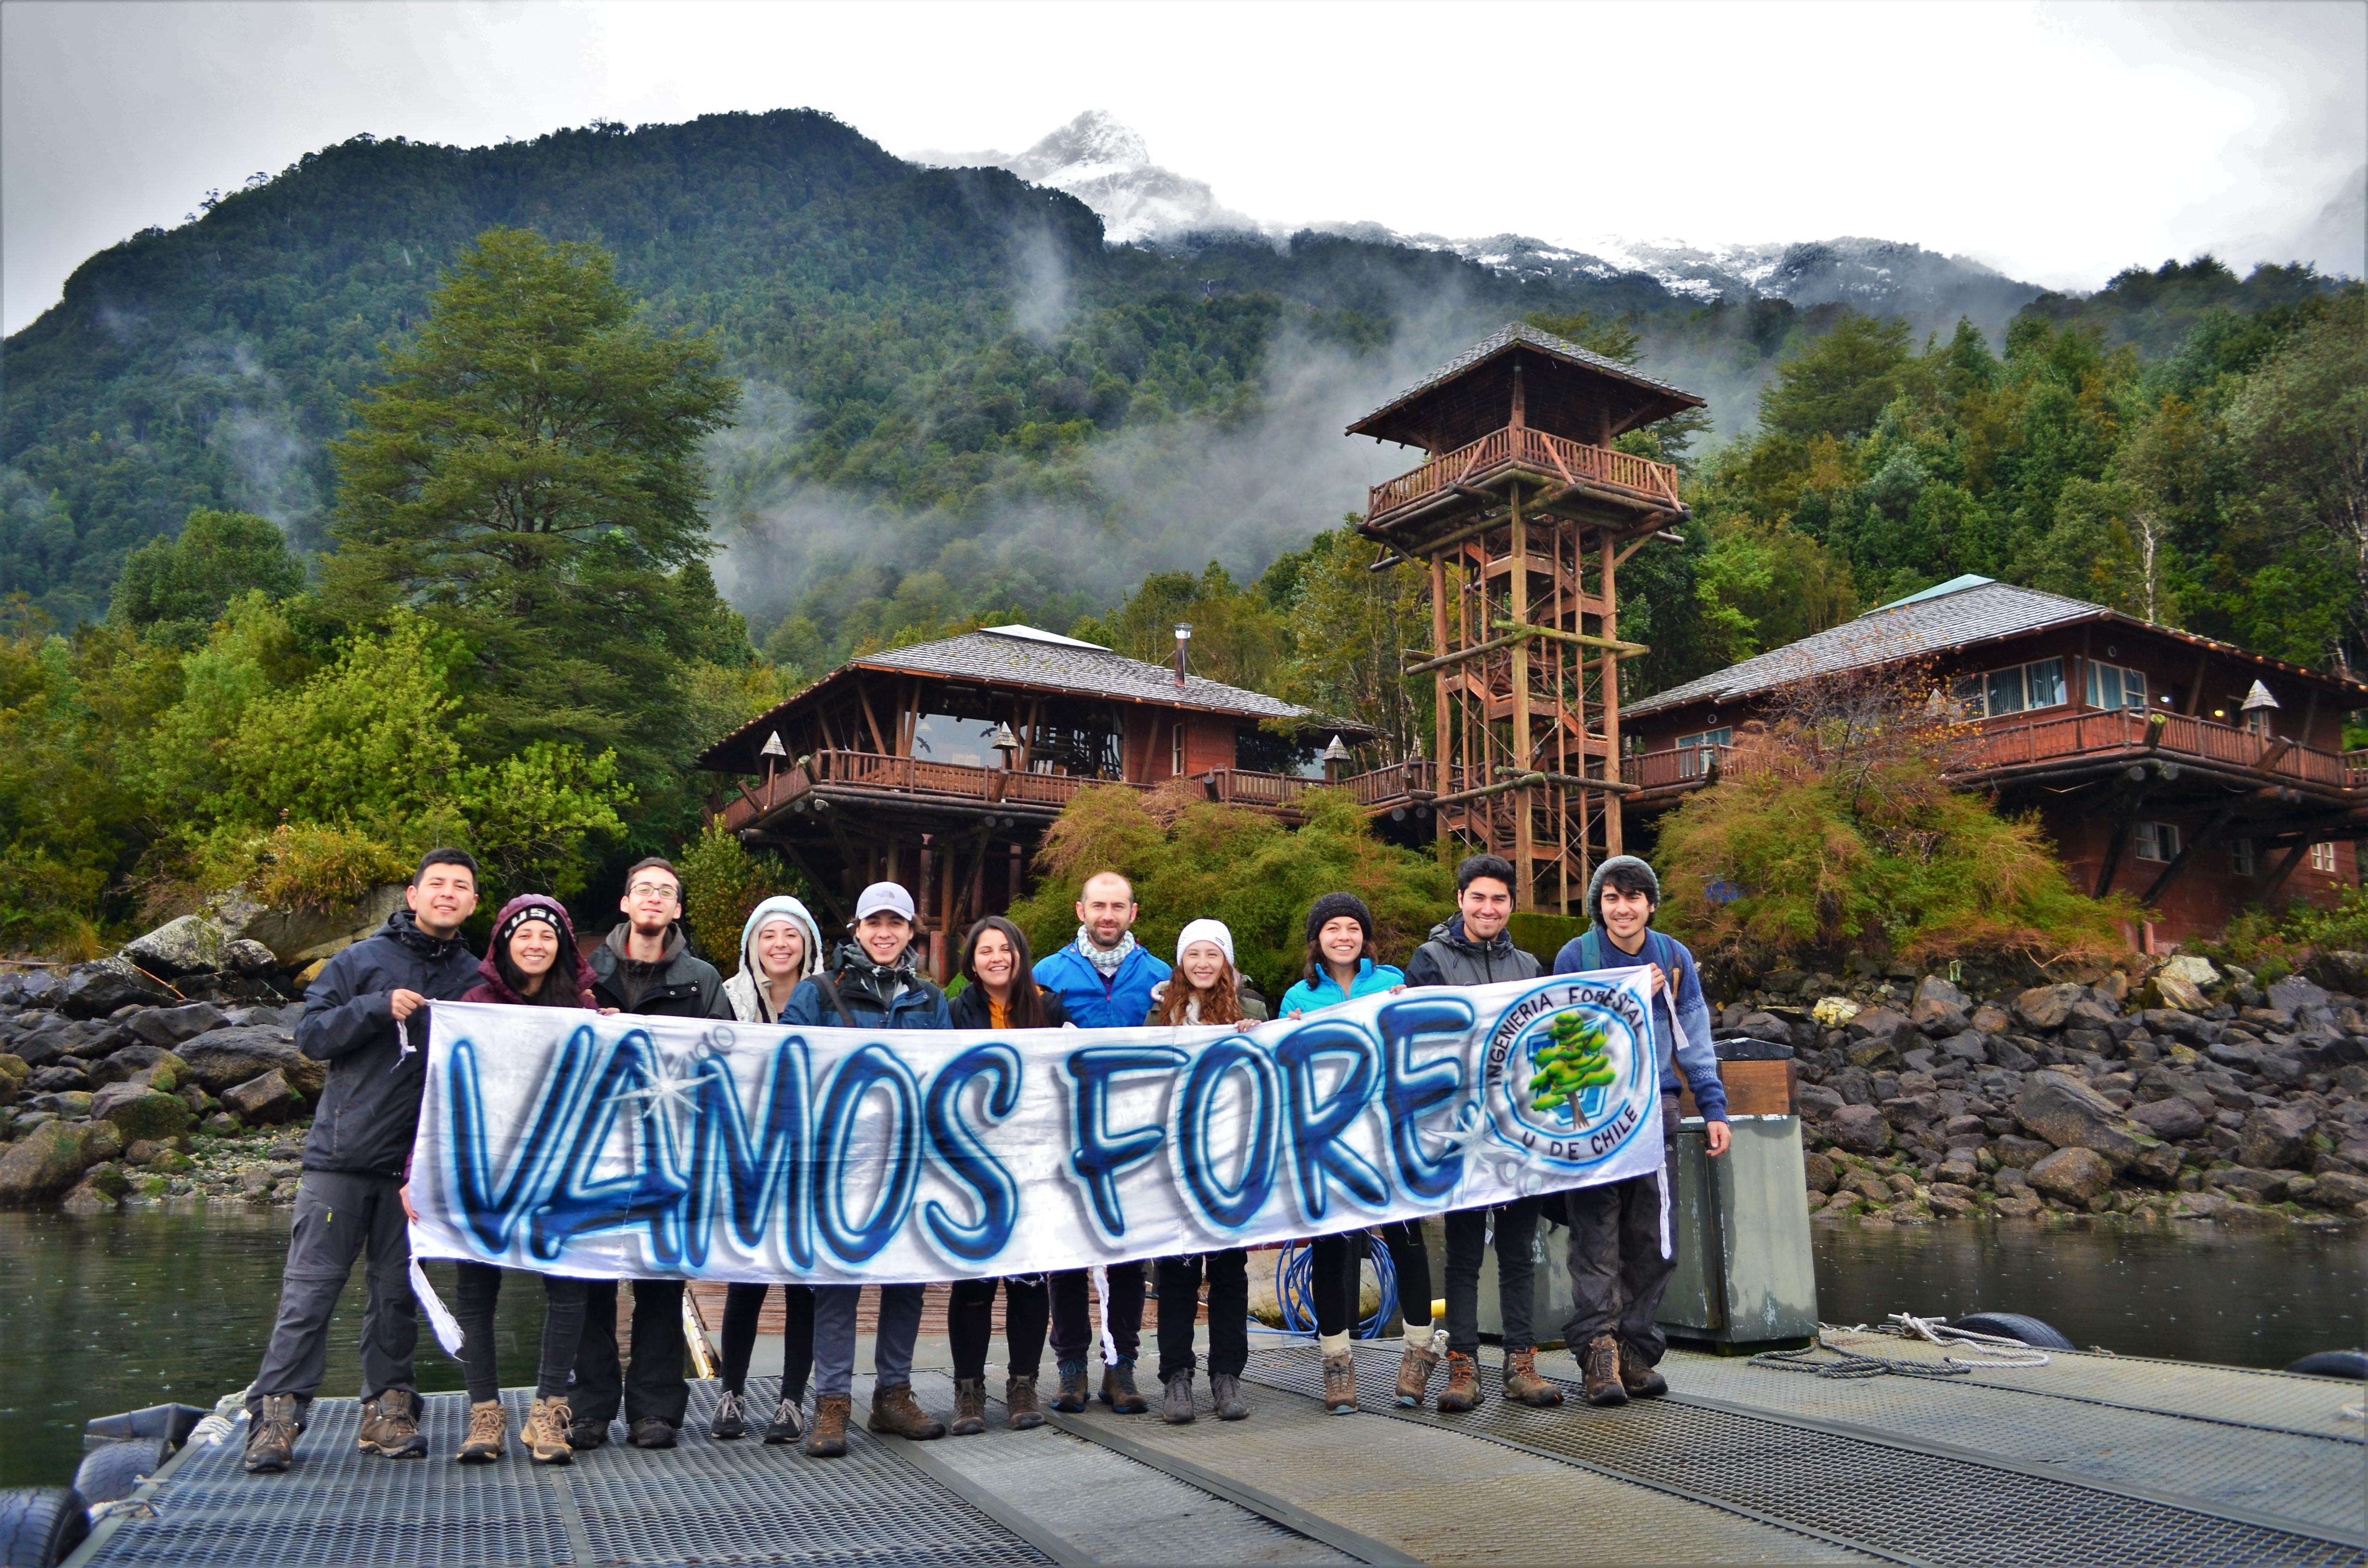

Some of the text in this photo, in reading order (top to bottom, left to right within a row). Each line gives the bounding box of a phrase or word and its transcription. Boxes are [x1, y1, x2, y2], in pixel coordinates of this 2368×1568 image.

[1487, 992, 1554, 1085] INGENIERIA
[1568, 987, 1643, 1037] FORESTAL
[448, 1024, 1024, 1269] VAMOS
[1068, 996, 1476, 1238] FORE
[1522, 1104, 1637, 1160] U DE CHILE
